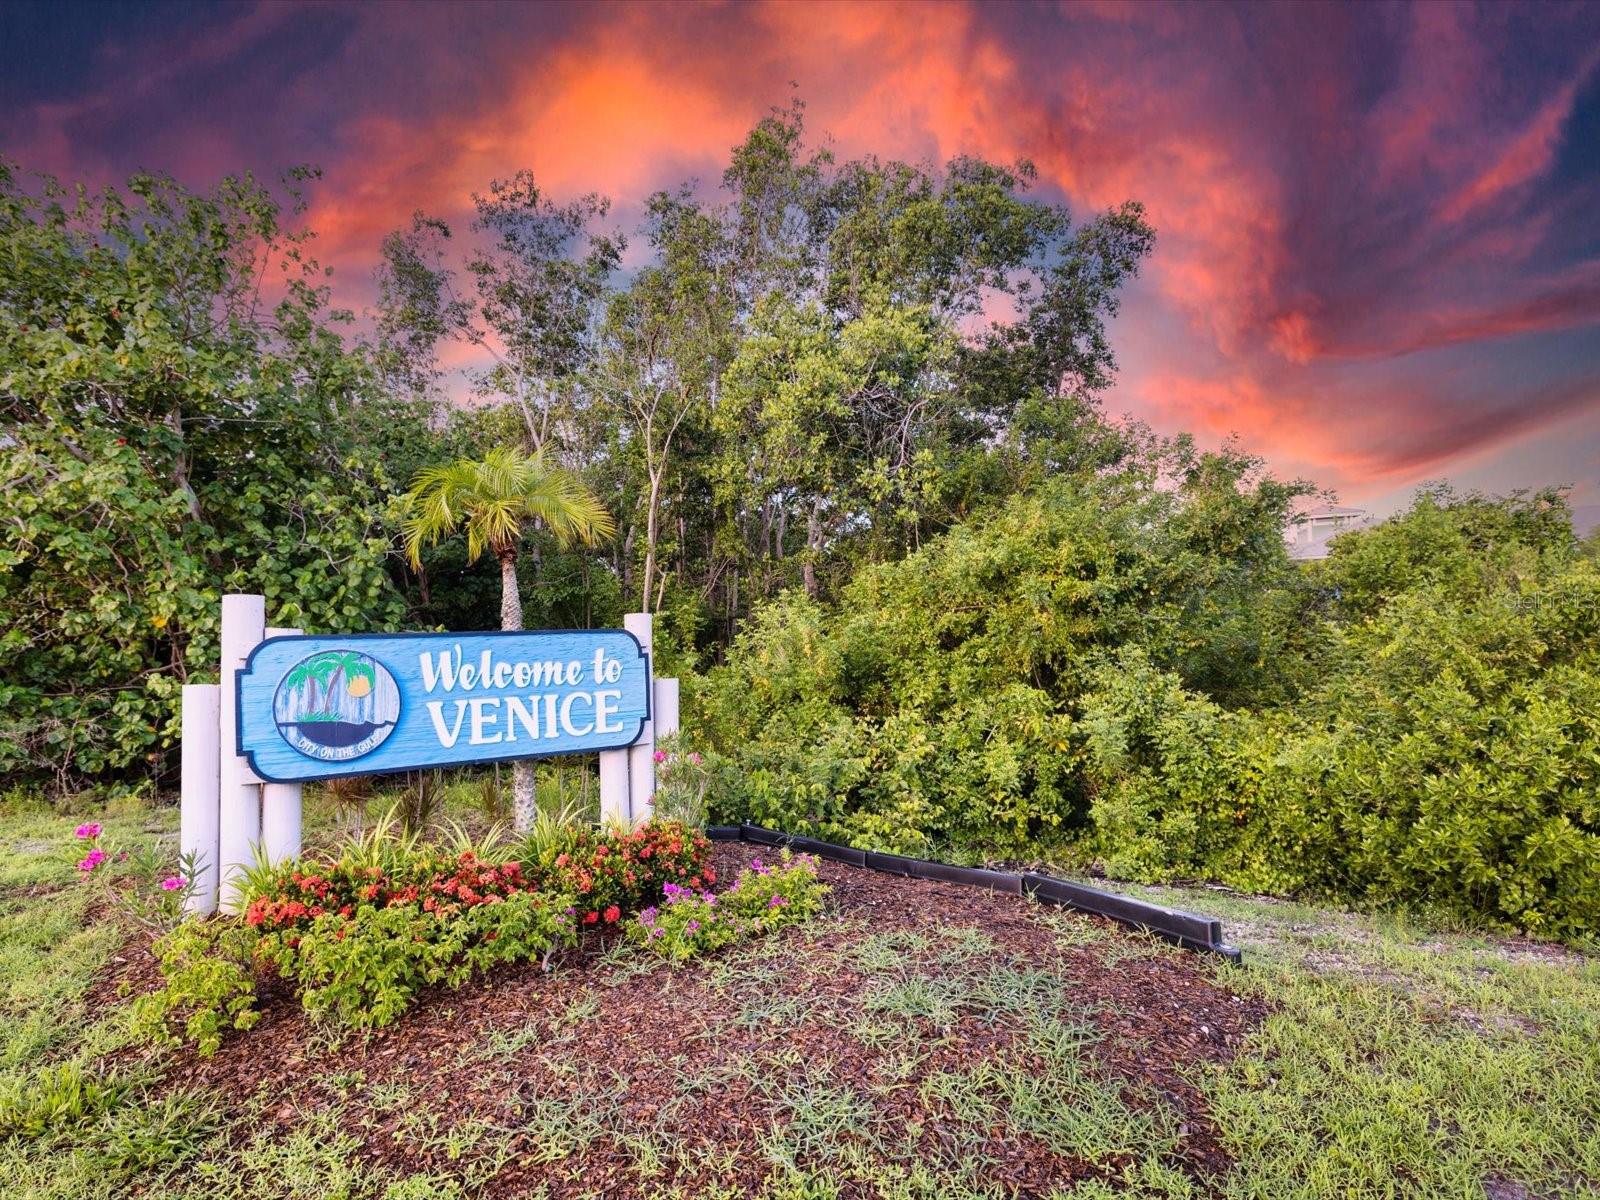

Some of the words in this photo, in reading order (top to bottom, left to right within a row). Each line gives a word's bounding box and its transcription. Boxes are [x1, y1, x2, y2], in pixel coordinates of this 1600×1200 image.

[419, 643, 585, 694] Welcome
[591, 648, 624, 684] to
[426, 690, 623, 749] VENICE
[298, 738, 318, 754] CITY
[320, 748, 334, 758] ON
[336, 747, 354, 758] THE
[358, 735, 379, 751] GULF
